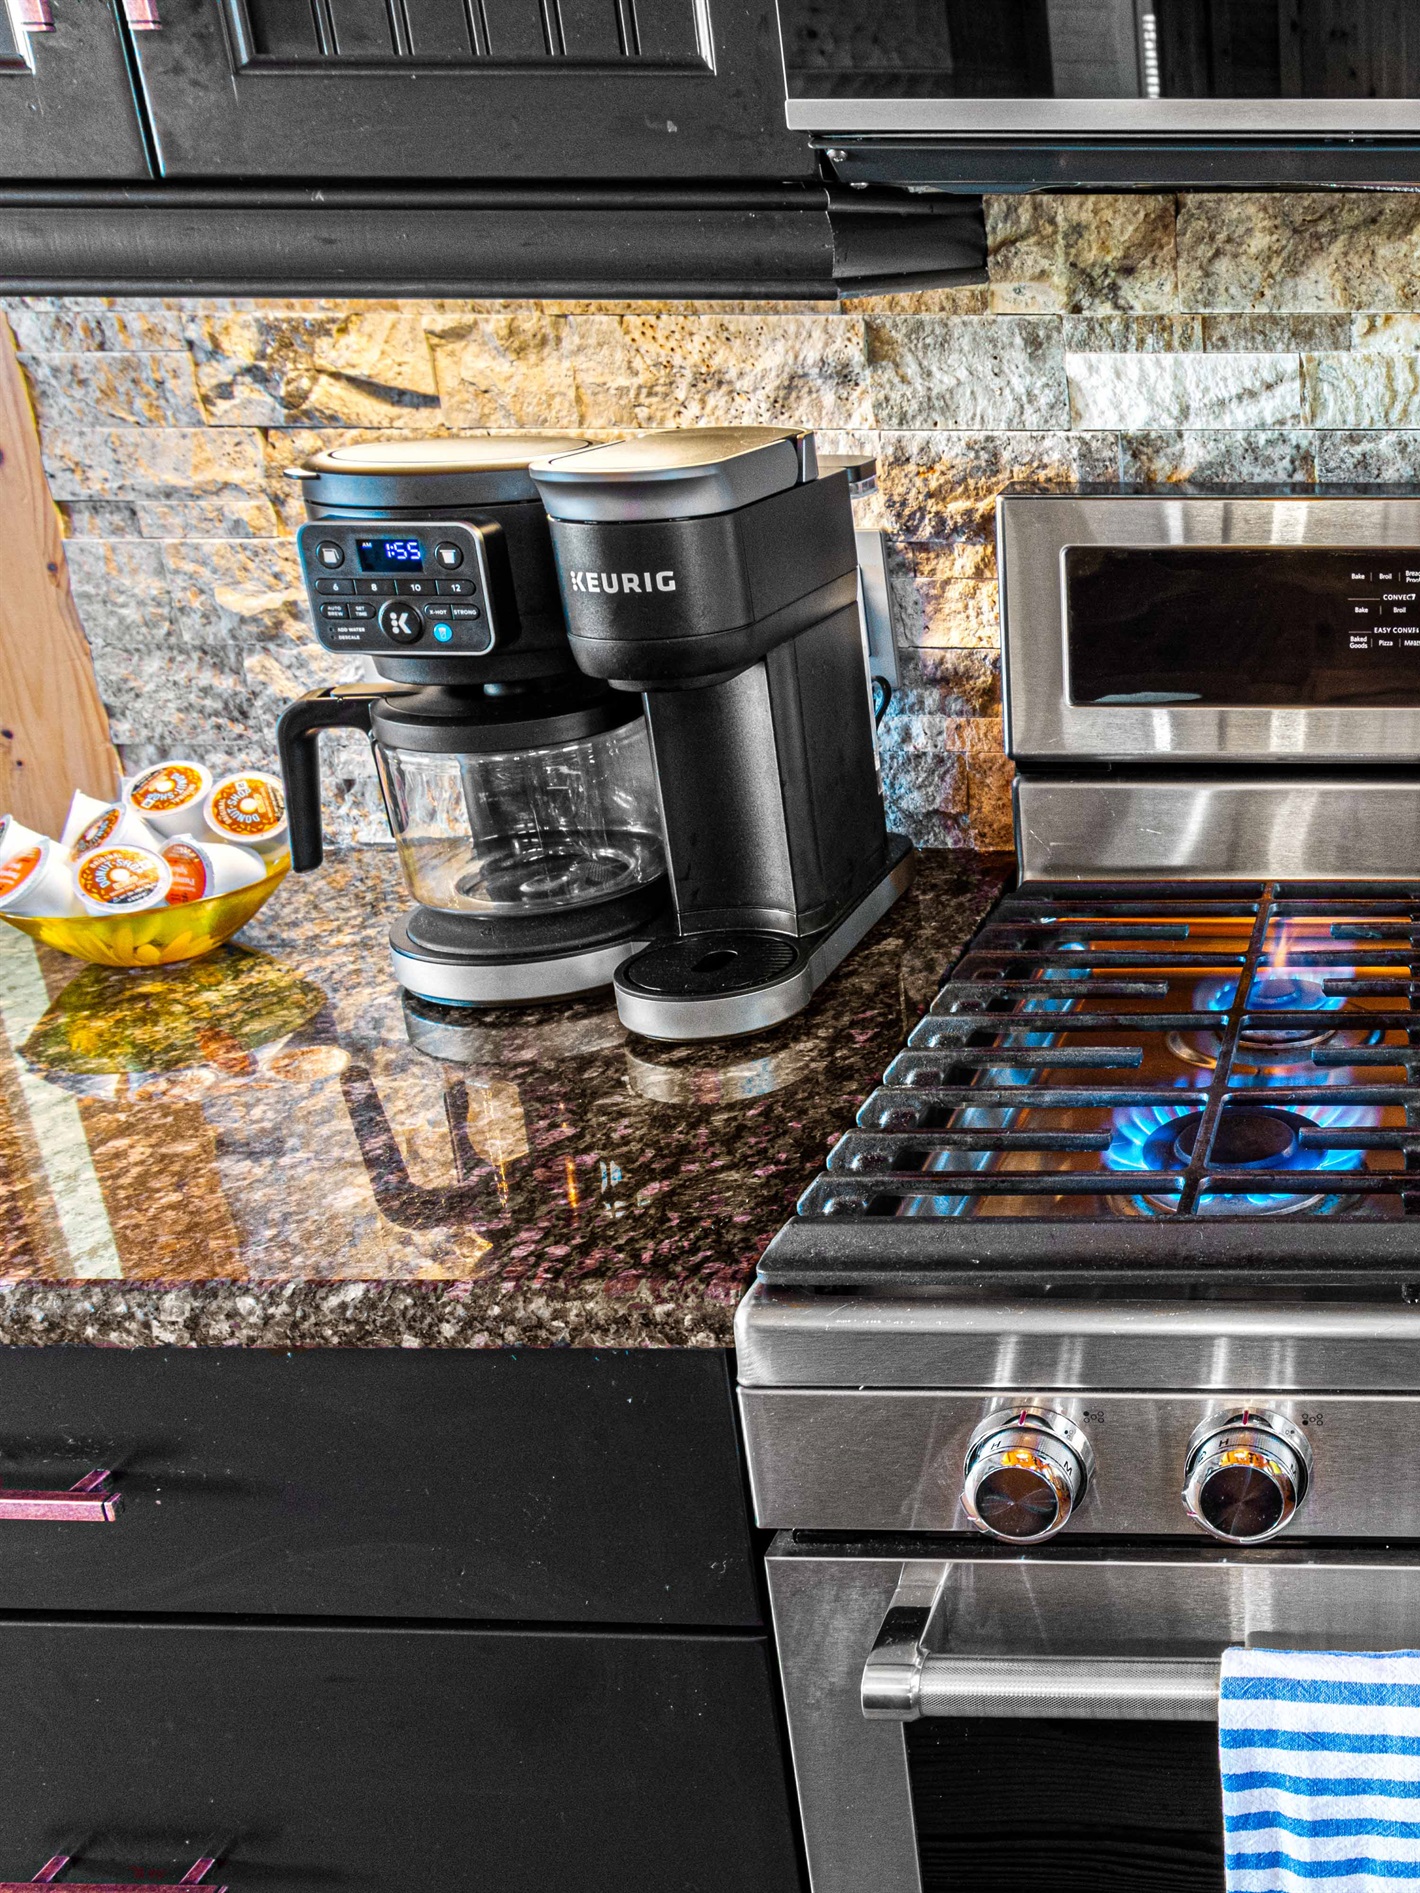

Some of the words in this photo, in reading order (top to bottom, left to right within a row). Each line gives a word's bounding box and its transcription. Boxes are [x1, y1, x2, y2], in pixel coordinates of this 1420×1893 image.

[385, 542, 421, 559] 1:55
[570, 570, 676, 594] KEURIG
[332, 583, 339, 592] 6
[370, 583, 378, 592] 8
[410, 583, 422, 592] 10
[451, 584, 462, 592] 12
[1218, 1438, 1229, 1447] H
